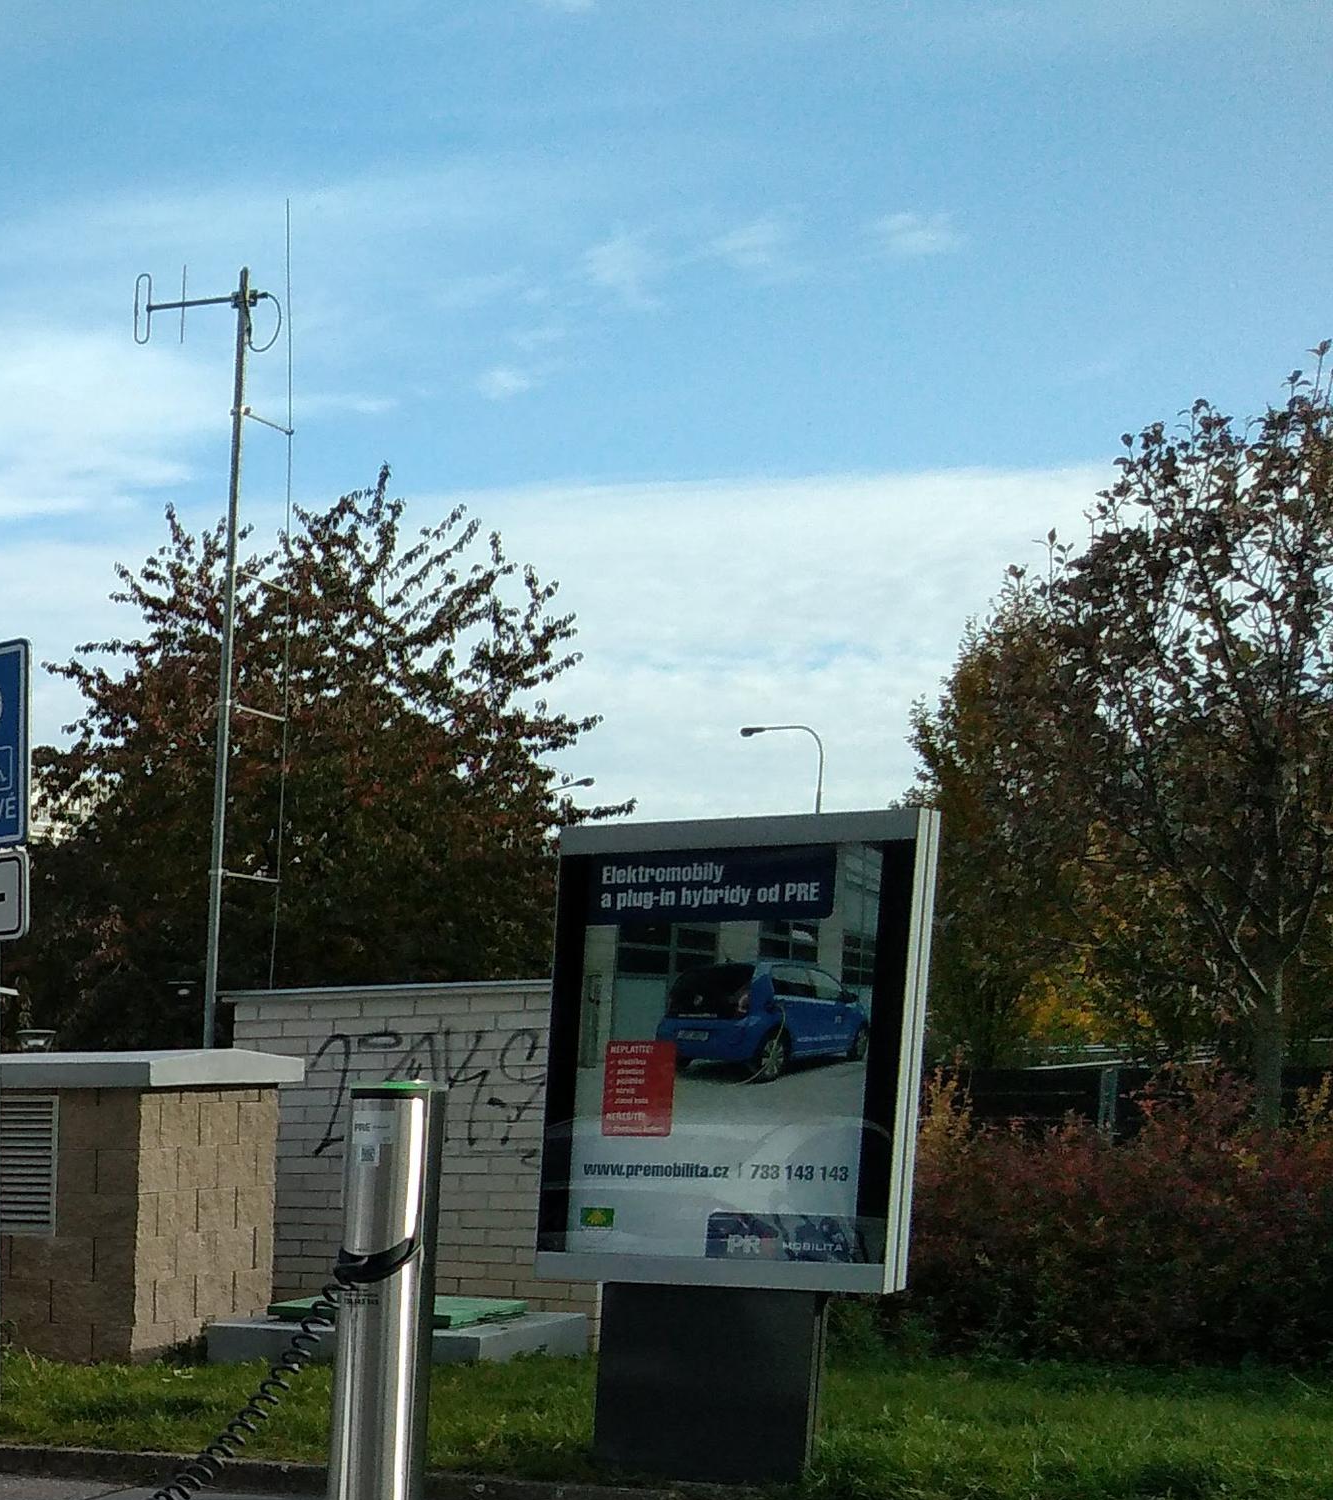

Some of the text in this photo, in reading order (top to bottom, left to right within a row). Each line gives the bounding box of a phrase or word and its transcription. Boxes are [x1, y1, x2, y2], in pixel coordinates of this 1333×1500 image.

[601, 862, 724, 885] Elektromobily
[600, 881, 821, 910] a plug-in hybridy od PRE
[583, 1162, 849, 1181] www.premobilita.cz 733 143 143
[783, 1241, 843, 1252] MOBILITA
